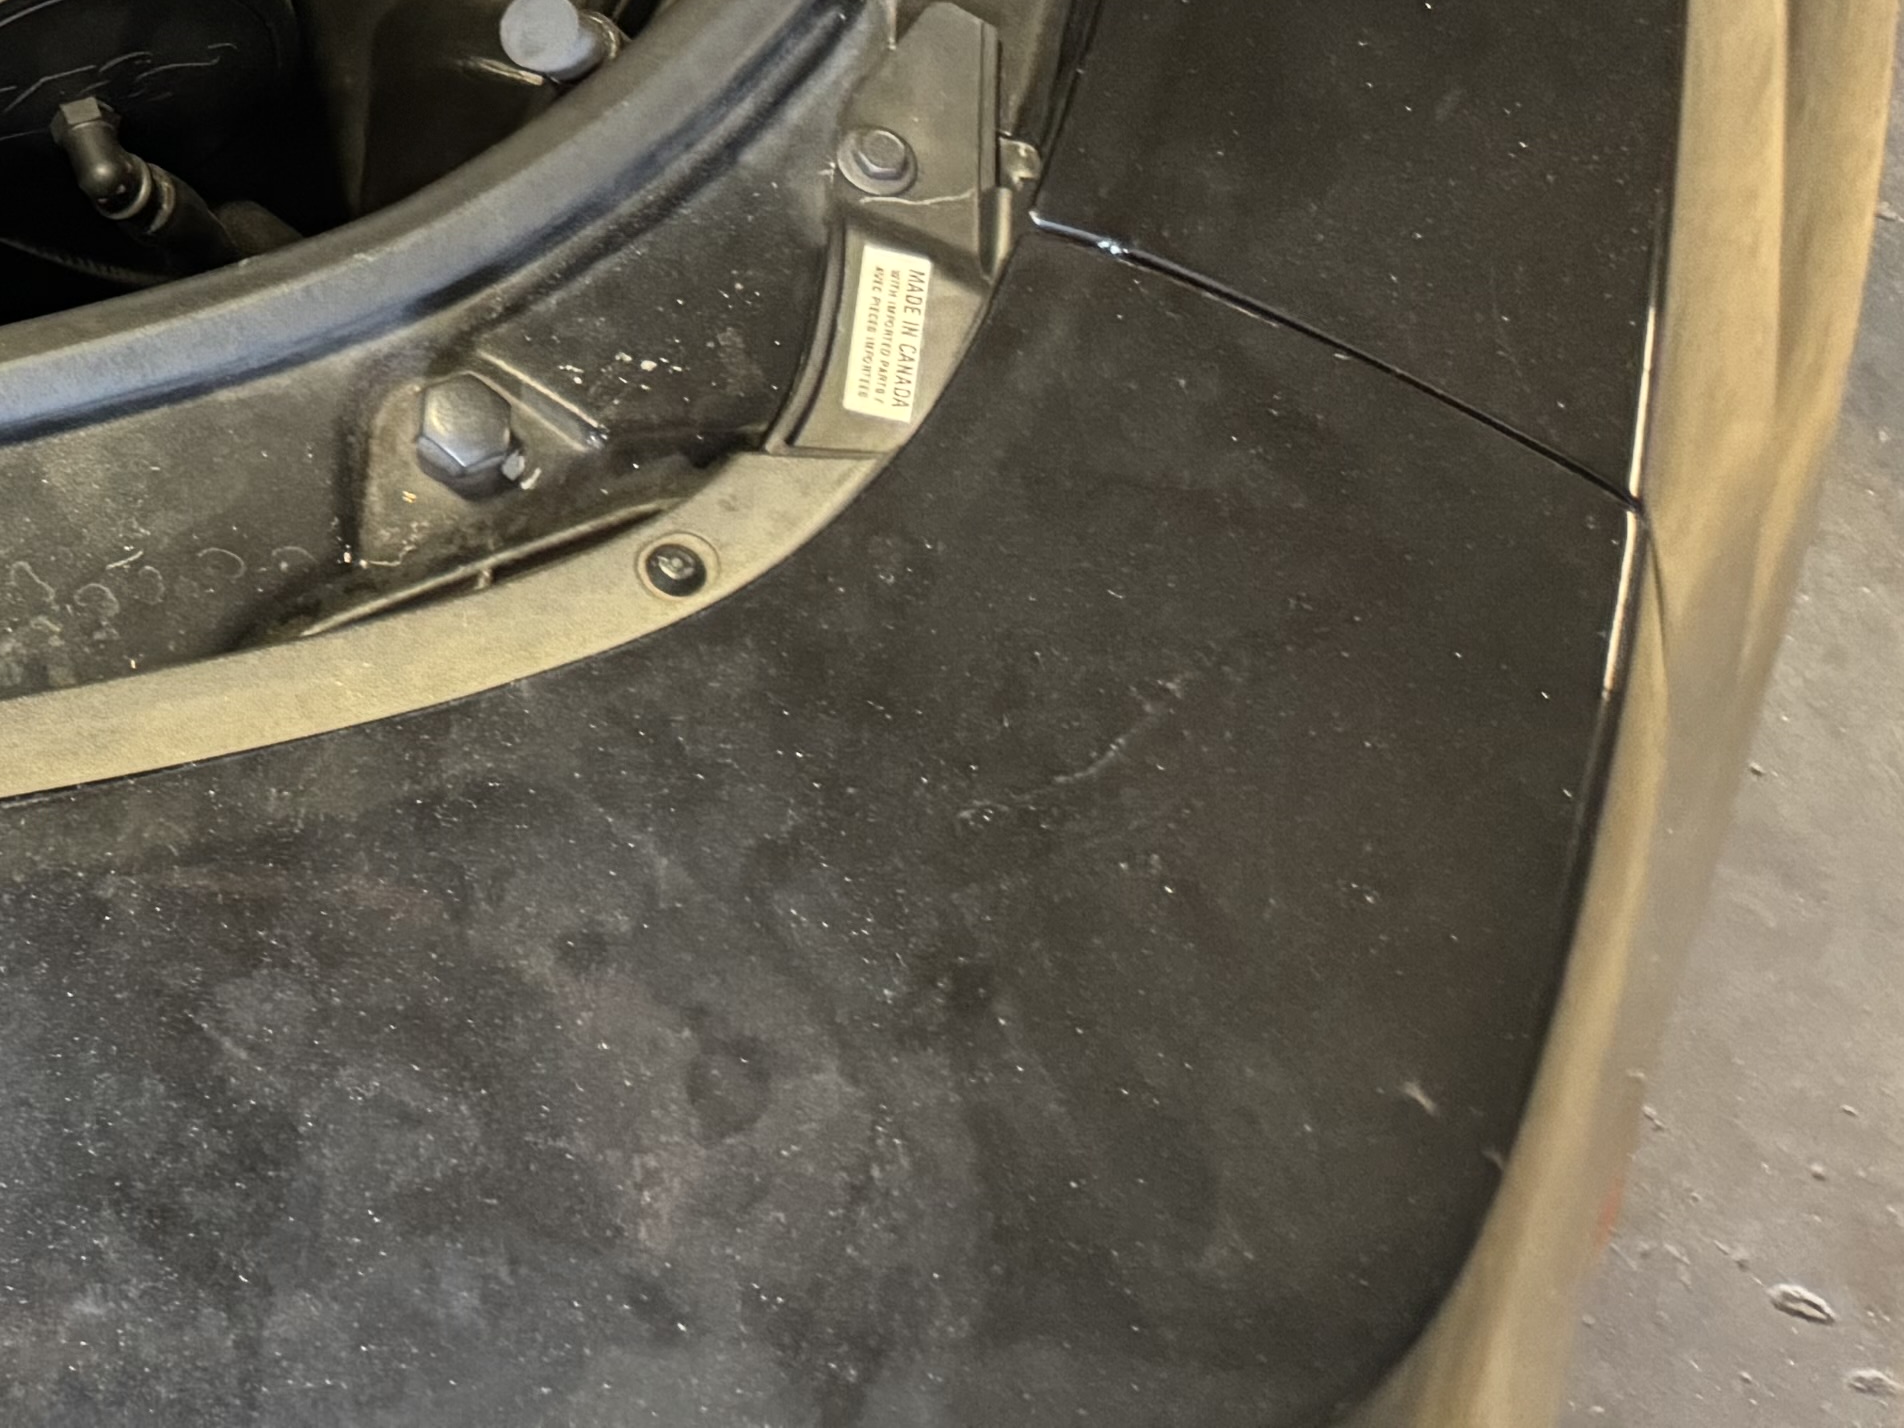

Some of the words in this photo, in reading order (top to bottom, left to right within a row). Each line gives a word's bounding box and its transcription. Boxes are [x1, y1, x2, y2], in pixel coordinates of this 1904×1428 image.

[887, 269, 901, 297] WITH
[902, 268, 925, 315] MADE
[878, 300, 896, 357] IMPORTED
[900, 319, 919, 338] IN
[890, 342, 916, 409] CANADA
